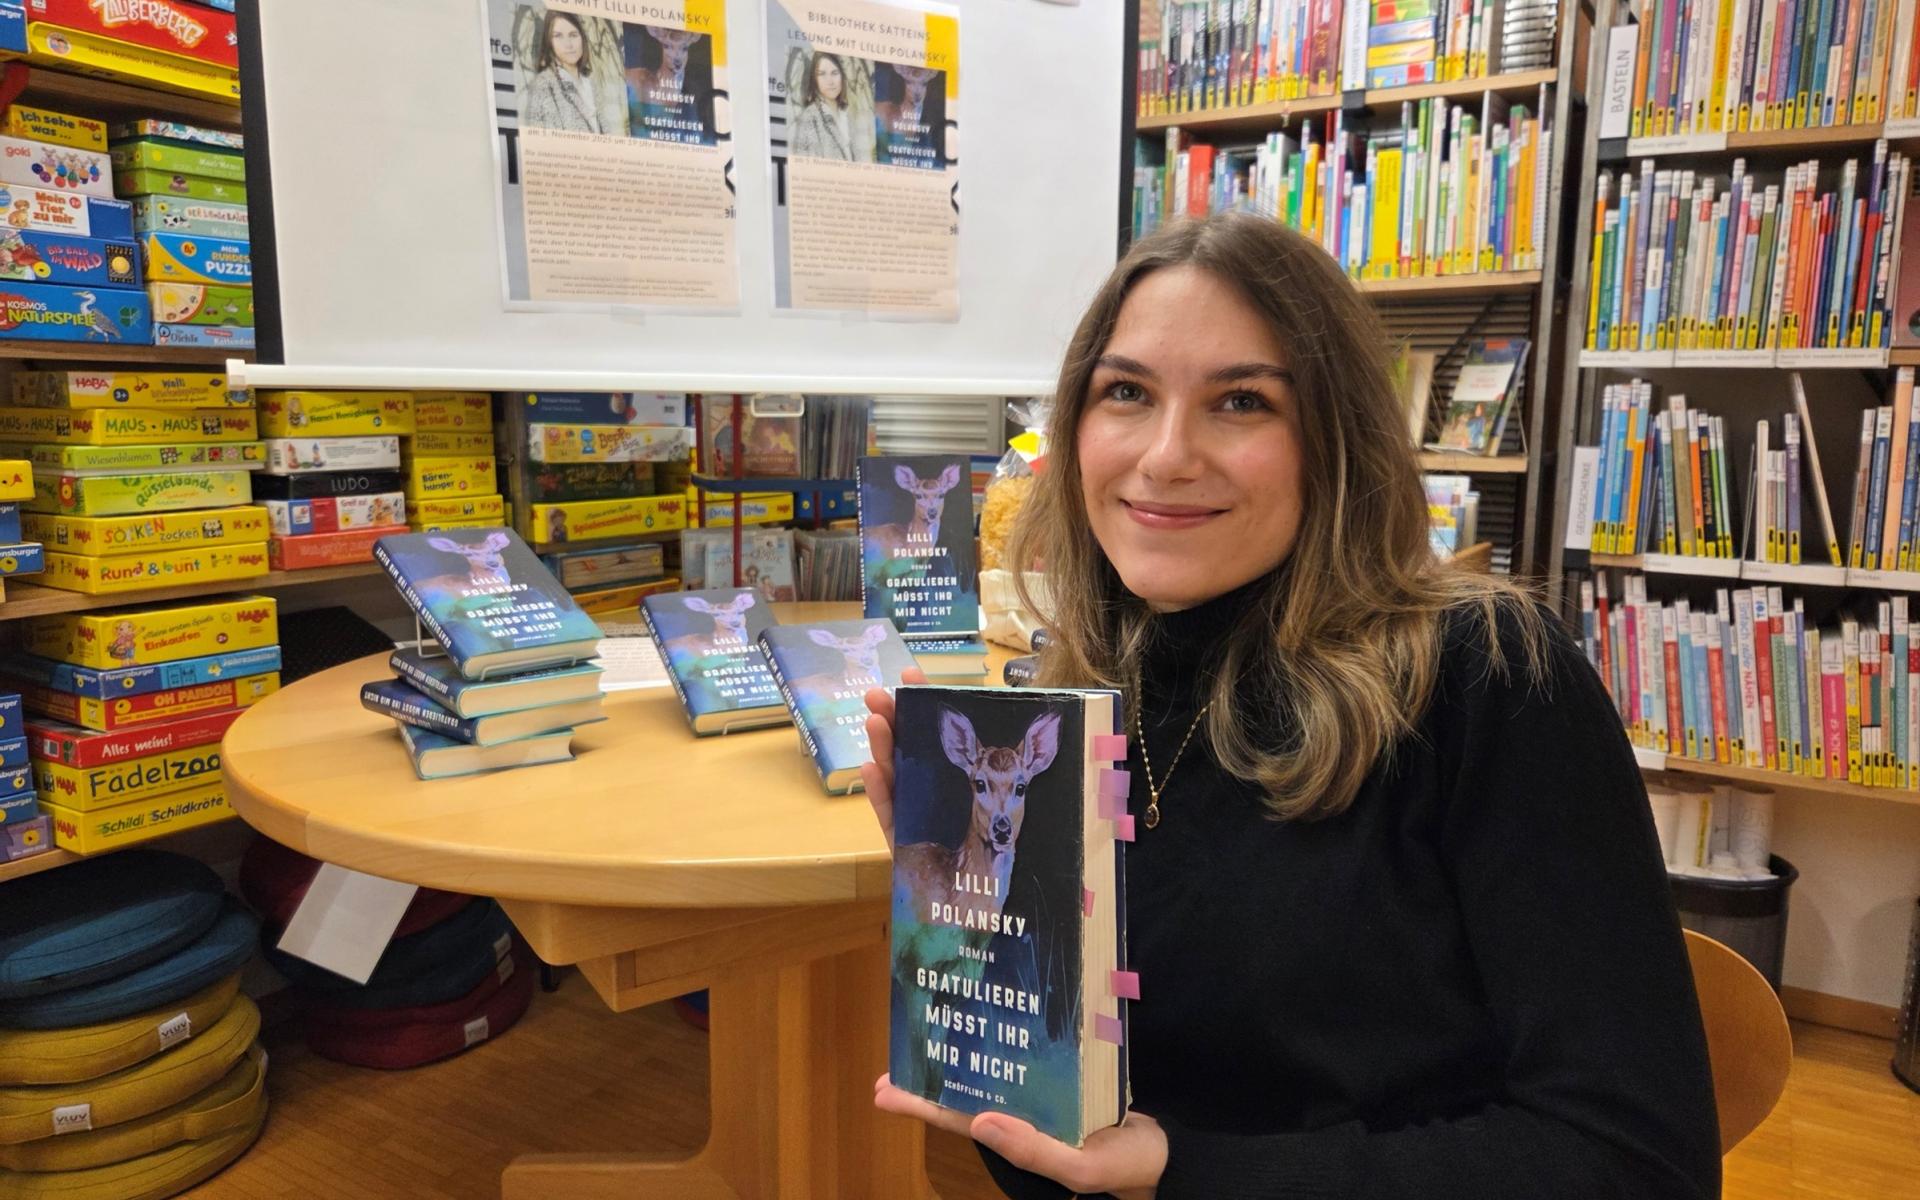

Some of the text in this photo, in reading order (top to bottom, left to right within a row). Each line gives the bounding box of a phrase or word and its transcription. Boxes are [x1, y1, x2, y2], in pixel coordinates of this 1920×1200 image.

[605, 2, 637, 15] LILLI
[641, 6, 711, 26] POLANSKY
[808, 12, 931, 41] BIBLIOTHEK SATTEINS
[788, 29, 947, 64] LESUNG MIT LILLI POLANSKY
[1610, 49, 1630, 114] BASTELN
[20, 111, 75, 129] Ich sehe
[32, 125, 56, 136] was
[5, 146, 31, 157] goki
[35, 192, 66, 204] Mein
[37, 202, 65, 214] Tier
[33, 212, 74, 224] zu mir
[205, 260, 251, 276] PUZZL
[7, 301, 48, 311] KOSMOS
[7, 308, 97, 327] NATURSPIELE
[75, 377, 110, 389] HABA
[115, 390, 127, 399] 3+
[105, 417, 199, 434] MAUS HAUS
[87, 452, 152, 465] Wiesenblumen
[136, 476, 215, 507] Rüsselbande
[331, 476, 370, 492] LUDO
[423, 481, 454, 492] hunger
[657, 500, 681, 514] HABA
[104, 517, 165, 544] SOCKEN
[159, 527, 200, 542] zocken
[907, 532, 933, 543] LILLI
[376, 546, 391, 566] NICHT
[893, 547, 948, 557] POLANSKY
[100, 558, 201, 582] Rund & bunt
[462, 583, 529, 597] POLANSKY
[471, 576, 506, 587] LILLI
[886, 577, 957, 588] GRATULIEREN
[893, 590, 953, 602] MÜSST IHR
[236, 608, 271, 624] HABA
[466, 601, 555, 619] GRATULIEREN
[895, 606, 952, 617] MIR NICHT
[420, 606, 452, 649] GRATULIEREN
[482, 611, 557, 628] MÜSST IHR
[491, 621, 563, 638] MIR NICHT
[144, 631, 201, 651] Einkaufen
[713, 636, 743, 646] LILLI
[759, 638, 773, 658] NICHT
[105, 666, 155, 682] Ravensburger
[703, 664, 768, 678] GRATULIER
[714, 675, 756, 687] MÜSST
[845, 676, 878, 686] LILLI
[1743, 670, 1756, 709] NÄHEN
[154, 682, 234, 707] OH PARDON
[720, 684, 779, 698] MIR NICH
[364, 691, 459, 727] GRATULIEREN MÜSST IHR MIR NICHT
[102, 743, 130, 758] Alles
[135, 734, 173, 752] meins!
[55, 776, 77, 795] HABA
[100, 795, 224, 834] Schildi Schildkröte
[56, 819, 78, 839] HABA
[955, 871, 1000, 898] LILLI
[931, 901, 1026, 938] POLANSKY
[958, 944, 995, 964] ROMAN
[916, 967, 1040, 1016] GRATULIEREN
[161, 1021, 187, 1038] VLUV
[925, 1003, 1030, 1050] MÜSST IHR
[927, 1038, 1028, 1086] MIR NICHT
[944, 1078, 1007, 1105] SCHÖFFLING & CO.
[56, 1113, 88, 1123] VLUV
